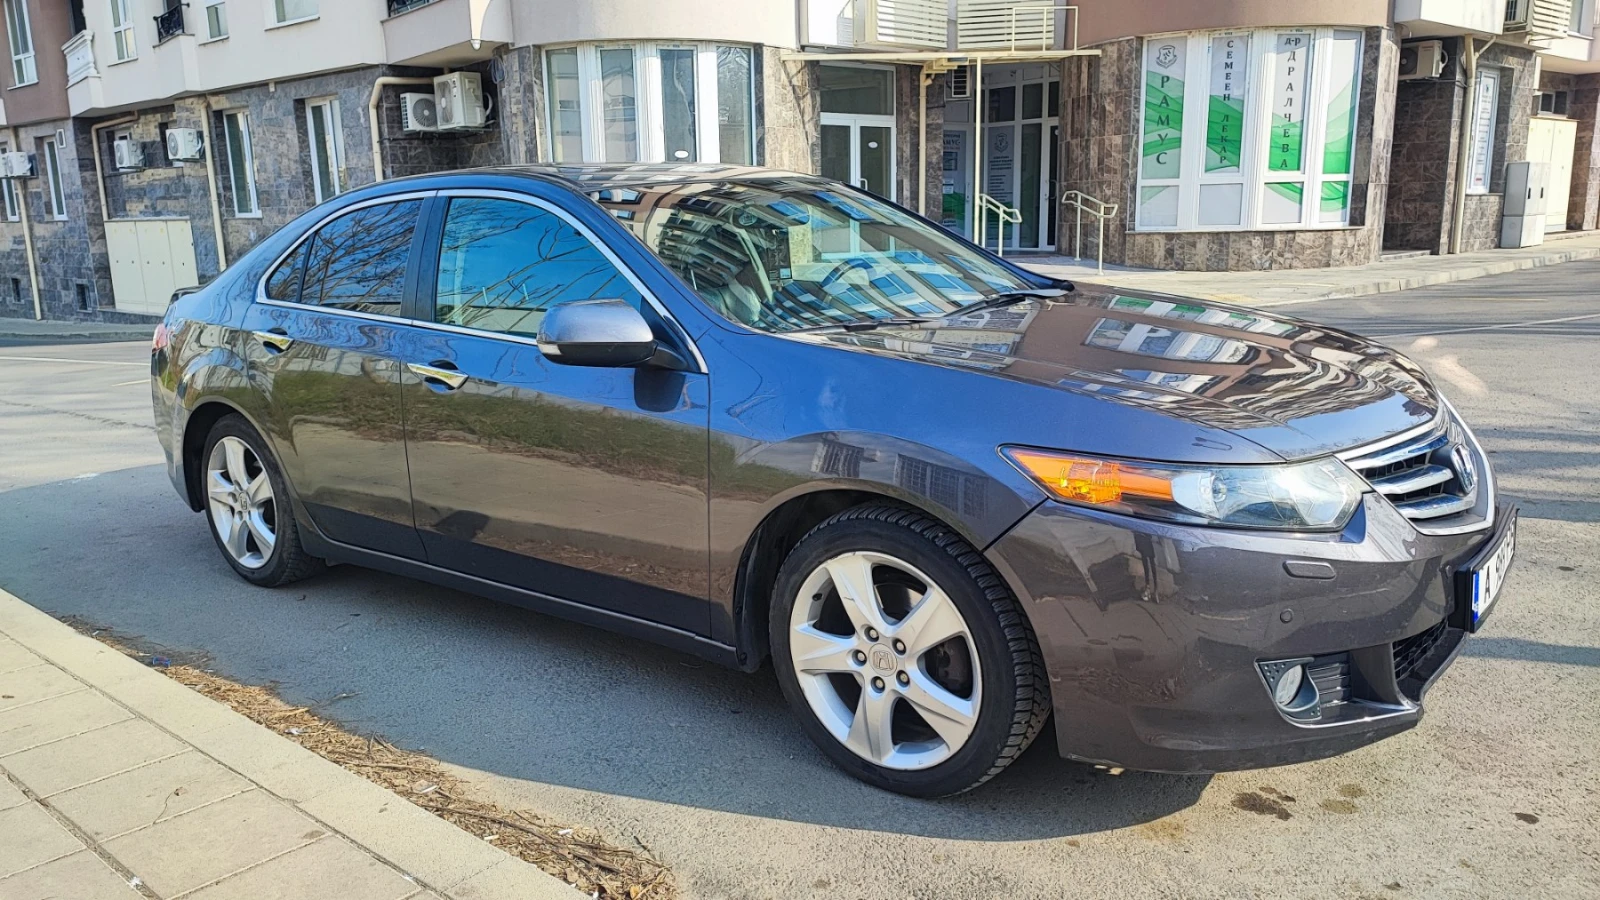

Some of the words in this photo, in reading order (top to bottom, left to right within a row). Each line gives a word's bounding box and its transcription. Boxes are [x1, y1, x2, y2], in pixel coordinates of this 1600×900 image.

[1223, 40, 1235, 102] СЕМЕЕН
[1156, 75, 1171, 165] РАМУС
[1219, 114, 1230, 164] ЛЕКАР
[1280, 51, 1297, 168] ДРАЛЧЕВА
